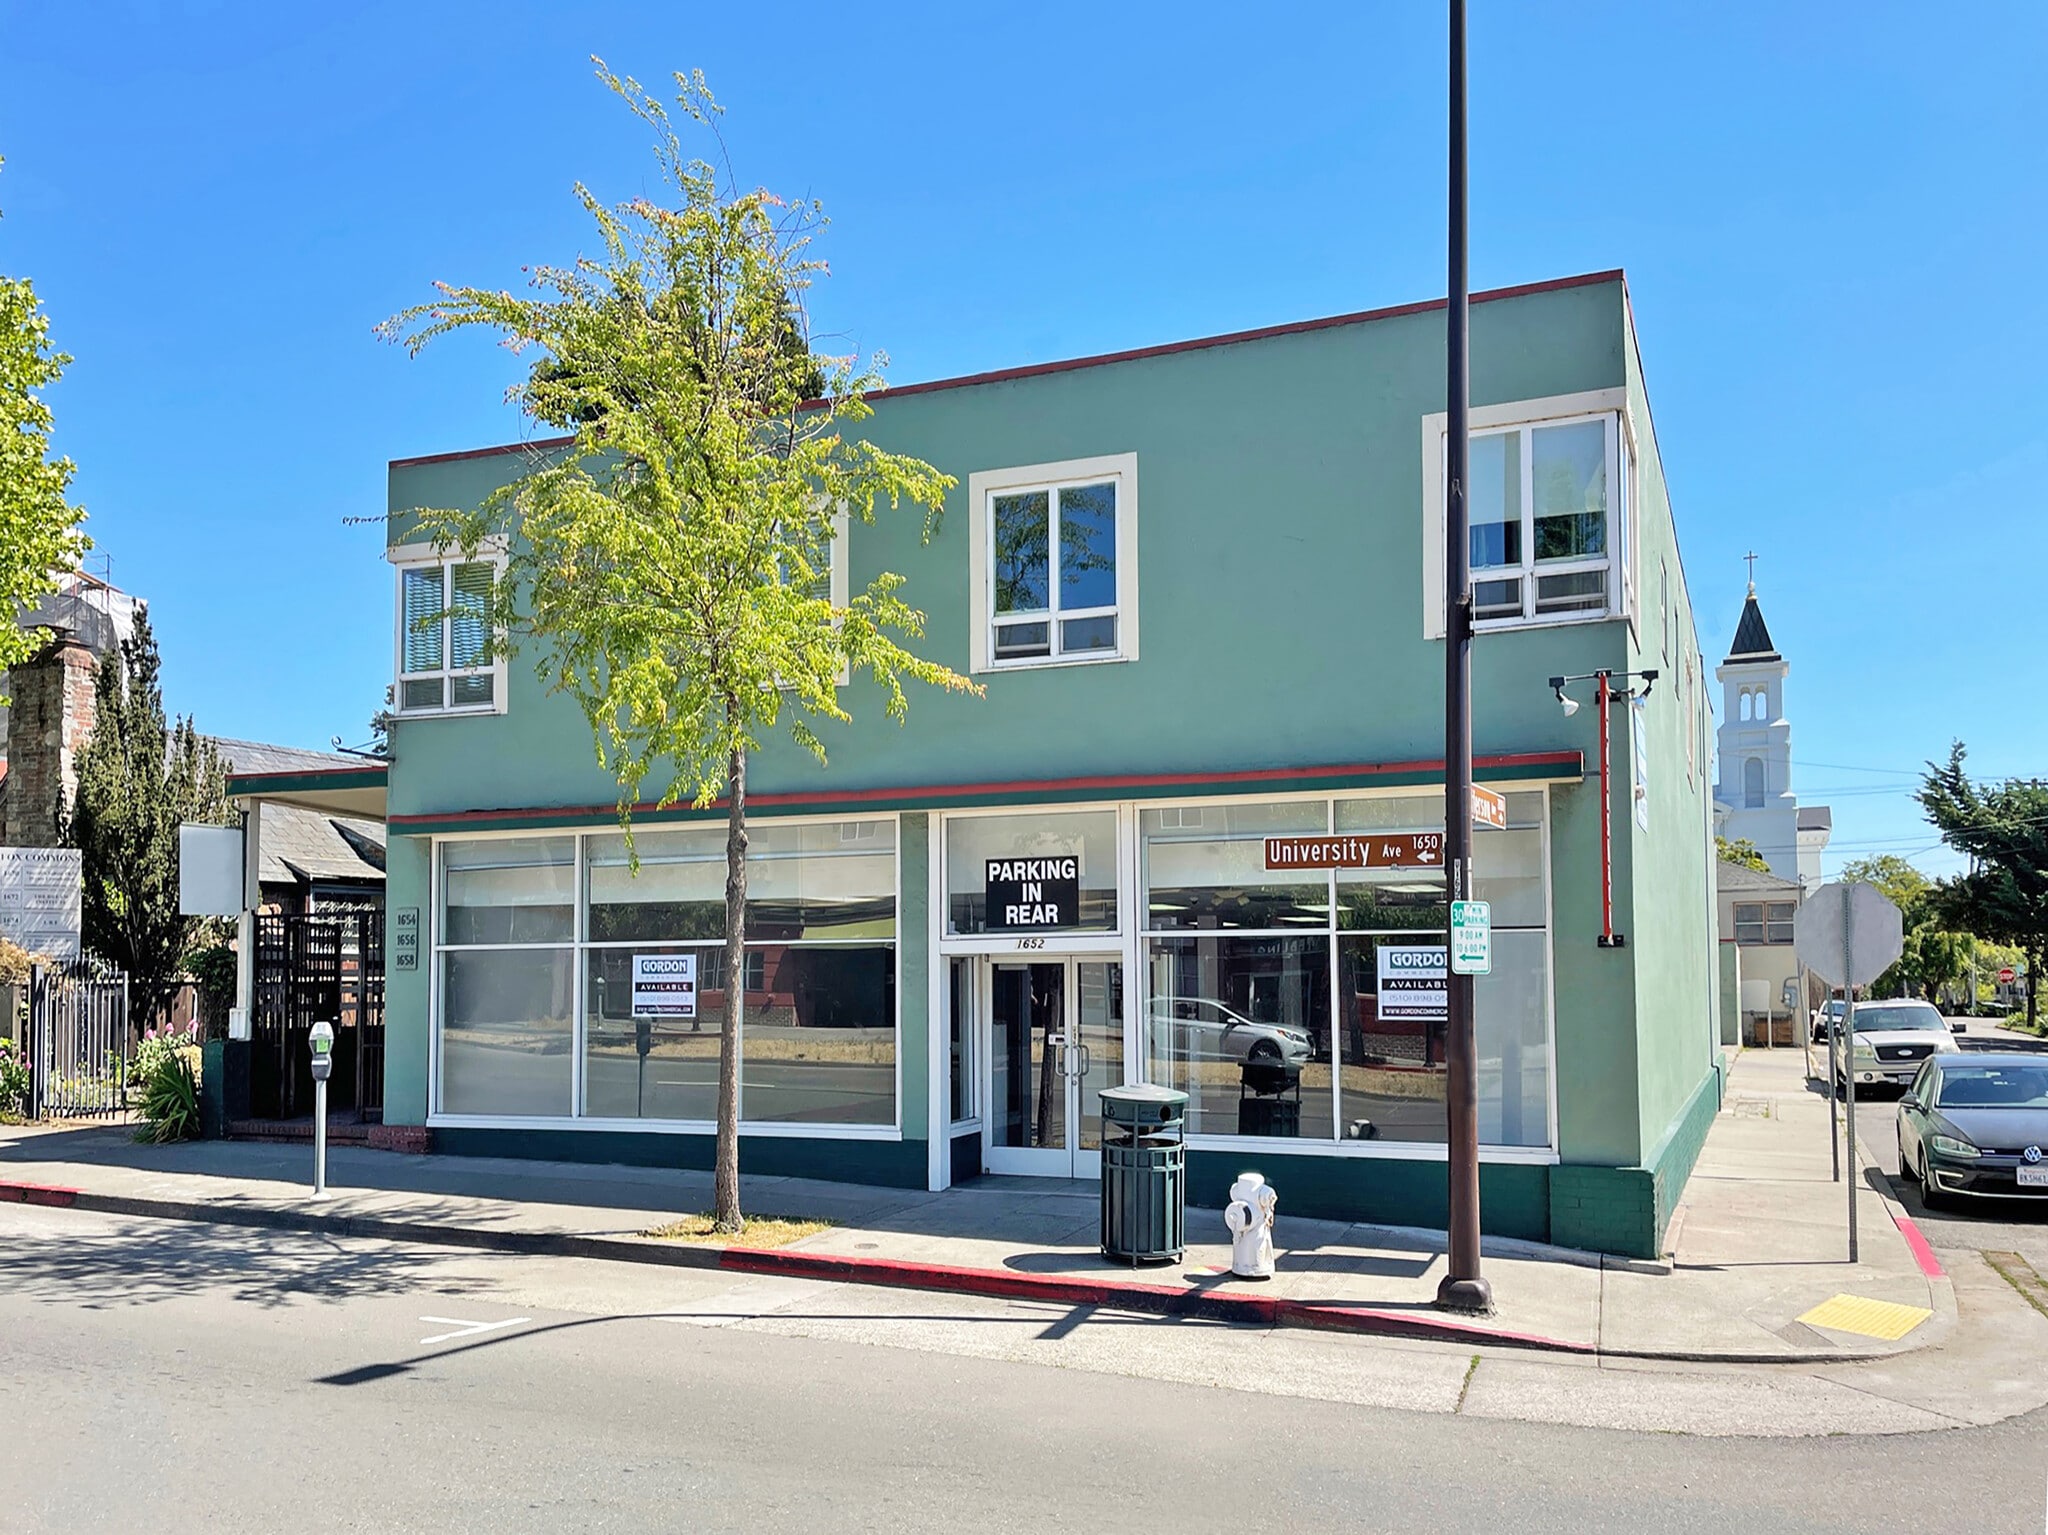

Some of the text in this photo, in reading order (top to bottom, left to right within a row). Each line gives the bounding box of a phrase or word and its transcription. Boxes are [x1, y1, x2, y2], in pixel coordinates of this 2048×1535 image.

[1413, 835, 1438, 849] 1650
[1270, 838, 1402, 867] University Ave
[989, 859, 1076, 881] PARKING
[1022, 882, 1042, 902] IN
[397, 914, 416, 925] 1654
[1006, 904, 1058, 924] REAR
[1453, 908, 1464, 923] 30
[397, 934, 416, 945] 1656
[1459, 930, 1474, 939] 900
[1016, 938, 1045, 949] 1652
[1464, 944, 1478, 953] 600
[396, 954, 415, 966] 1658
[642, 961, 687, 973] GORDON
